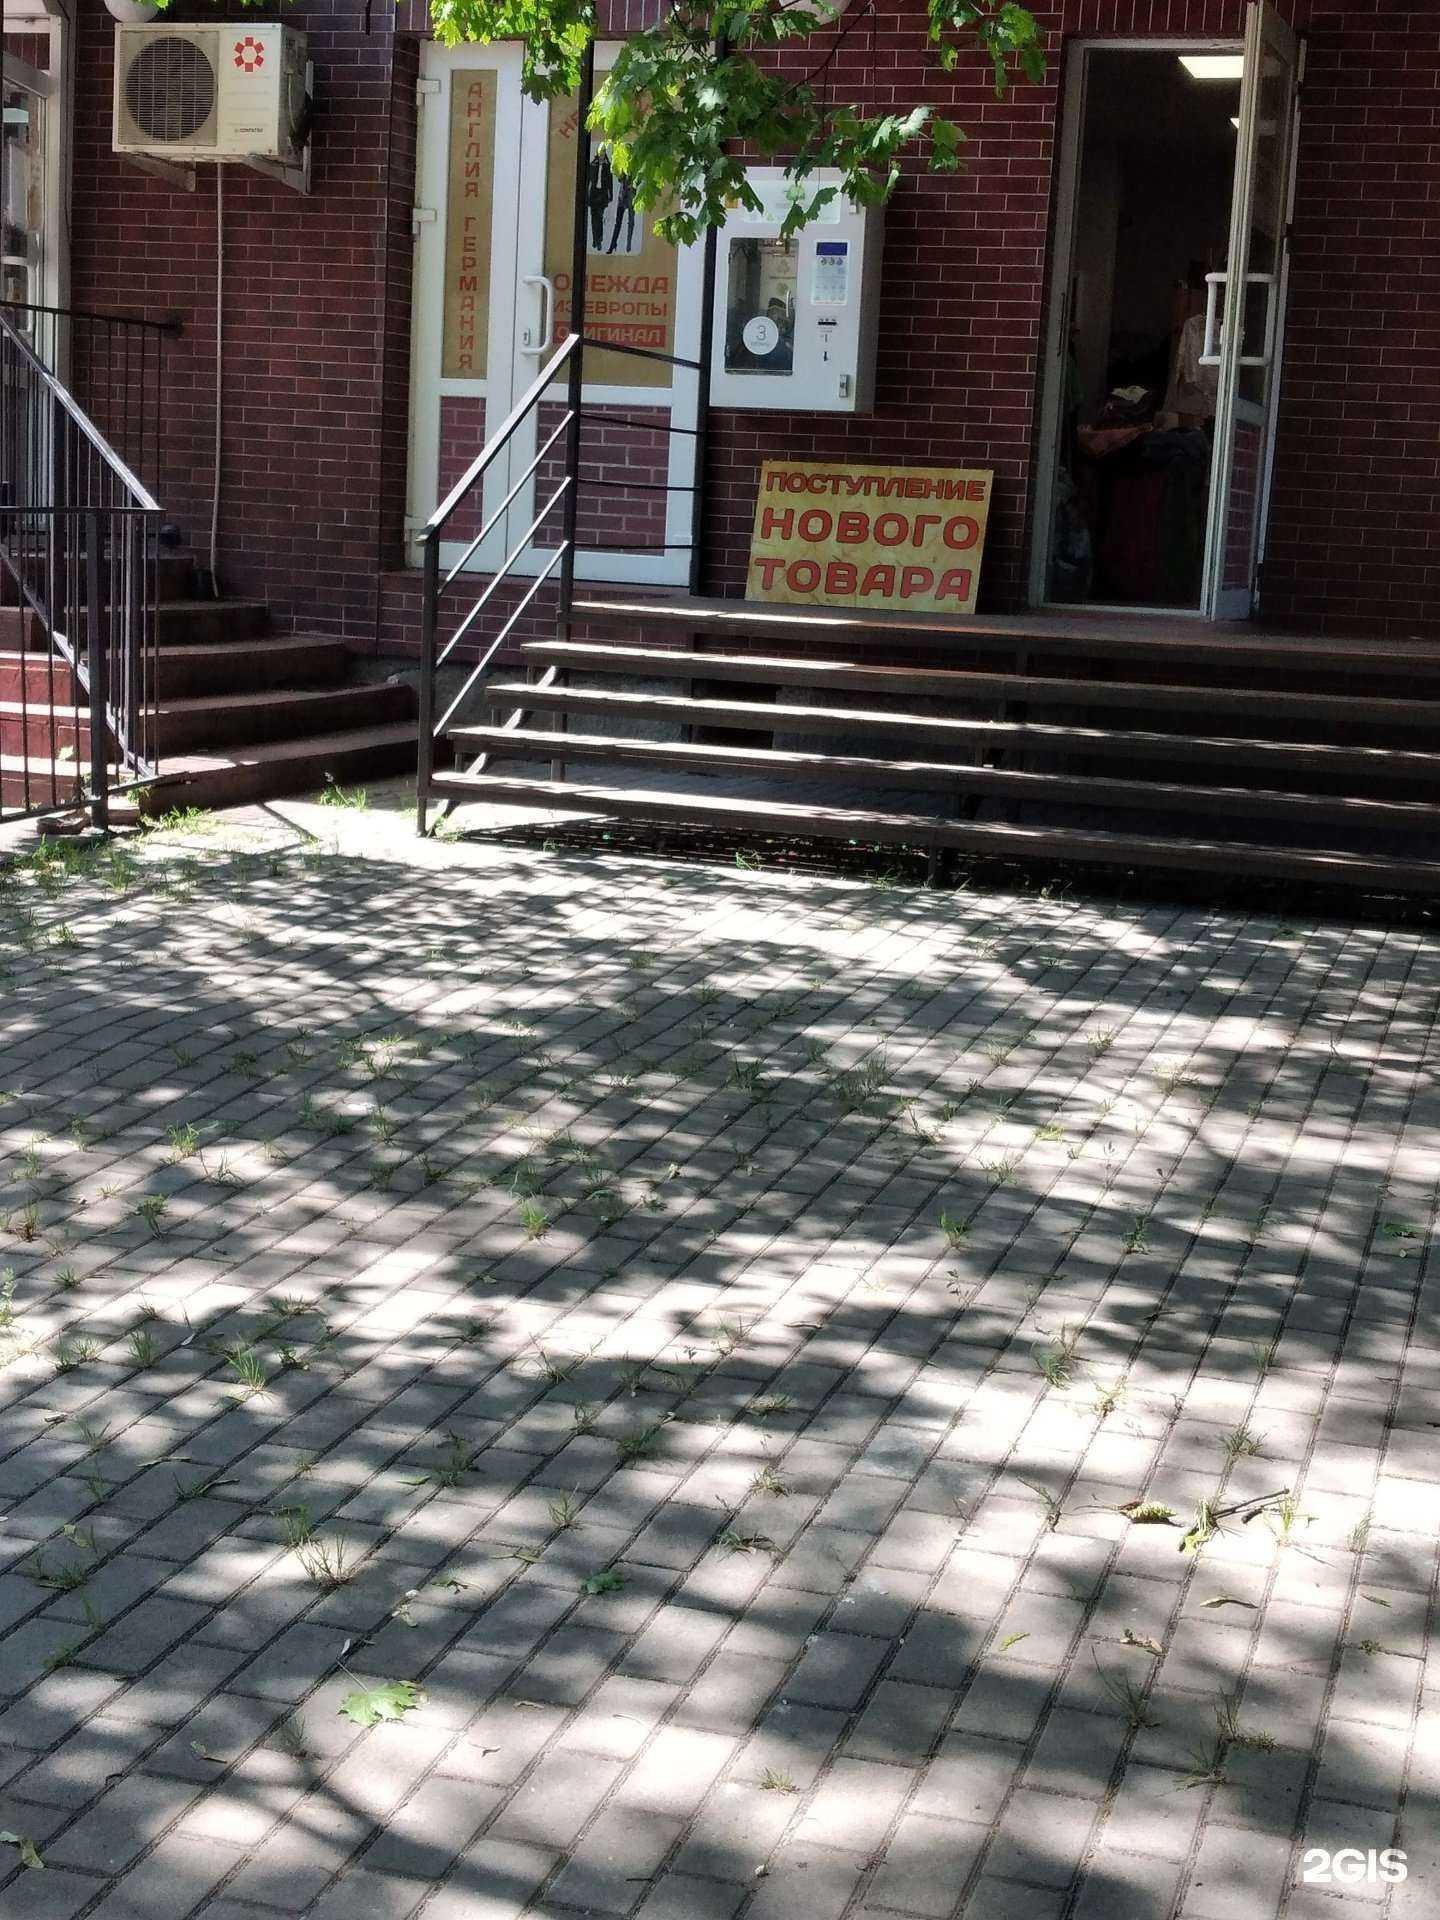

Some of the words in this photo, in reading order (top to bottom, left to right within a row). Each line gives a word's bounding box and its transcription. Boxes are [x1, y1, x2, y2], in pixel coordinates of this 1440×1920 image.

[464, 81, 483, 198] АНГЛИЯ
[458, 217, 480, 369] ГЕРМАНИЯ
[554, 273, 668, 293] ОЕЖДА
[583, 301, 668, 316] ЕВРОПЫ
[555, 325, 661, 344] ОИГИНАЛ
[756, 325, 767, 340] 3
[766, 471, 986, 502] ПОСТУПЛЕНИЕ
[760, 507, 980, 550] НОВОГО
[755, 557, 973, 602] ТОВАРА
